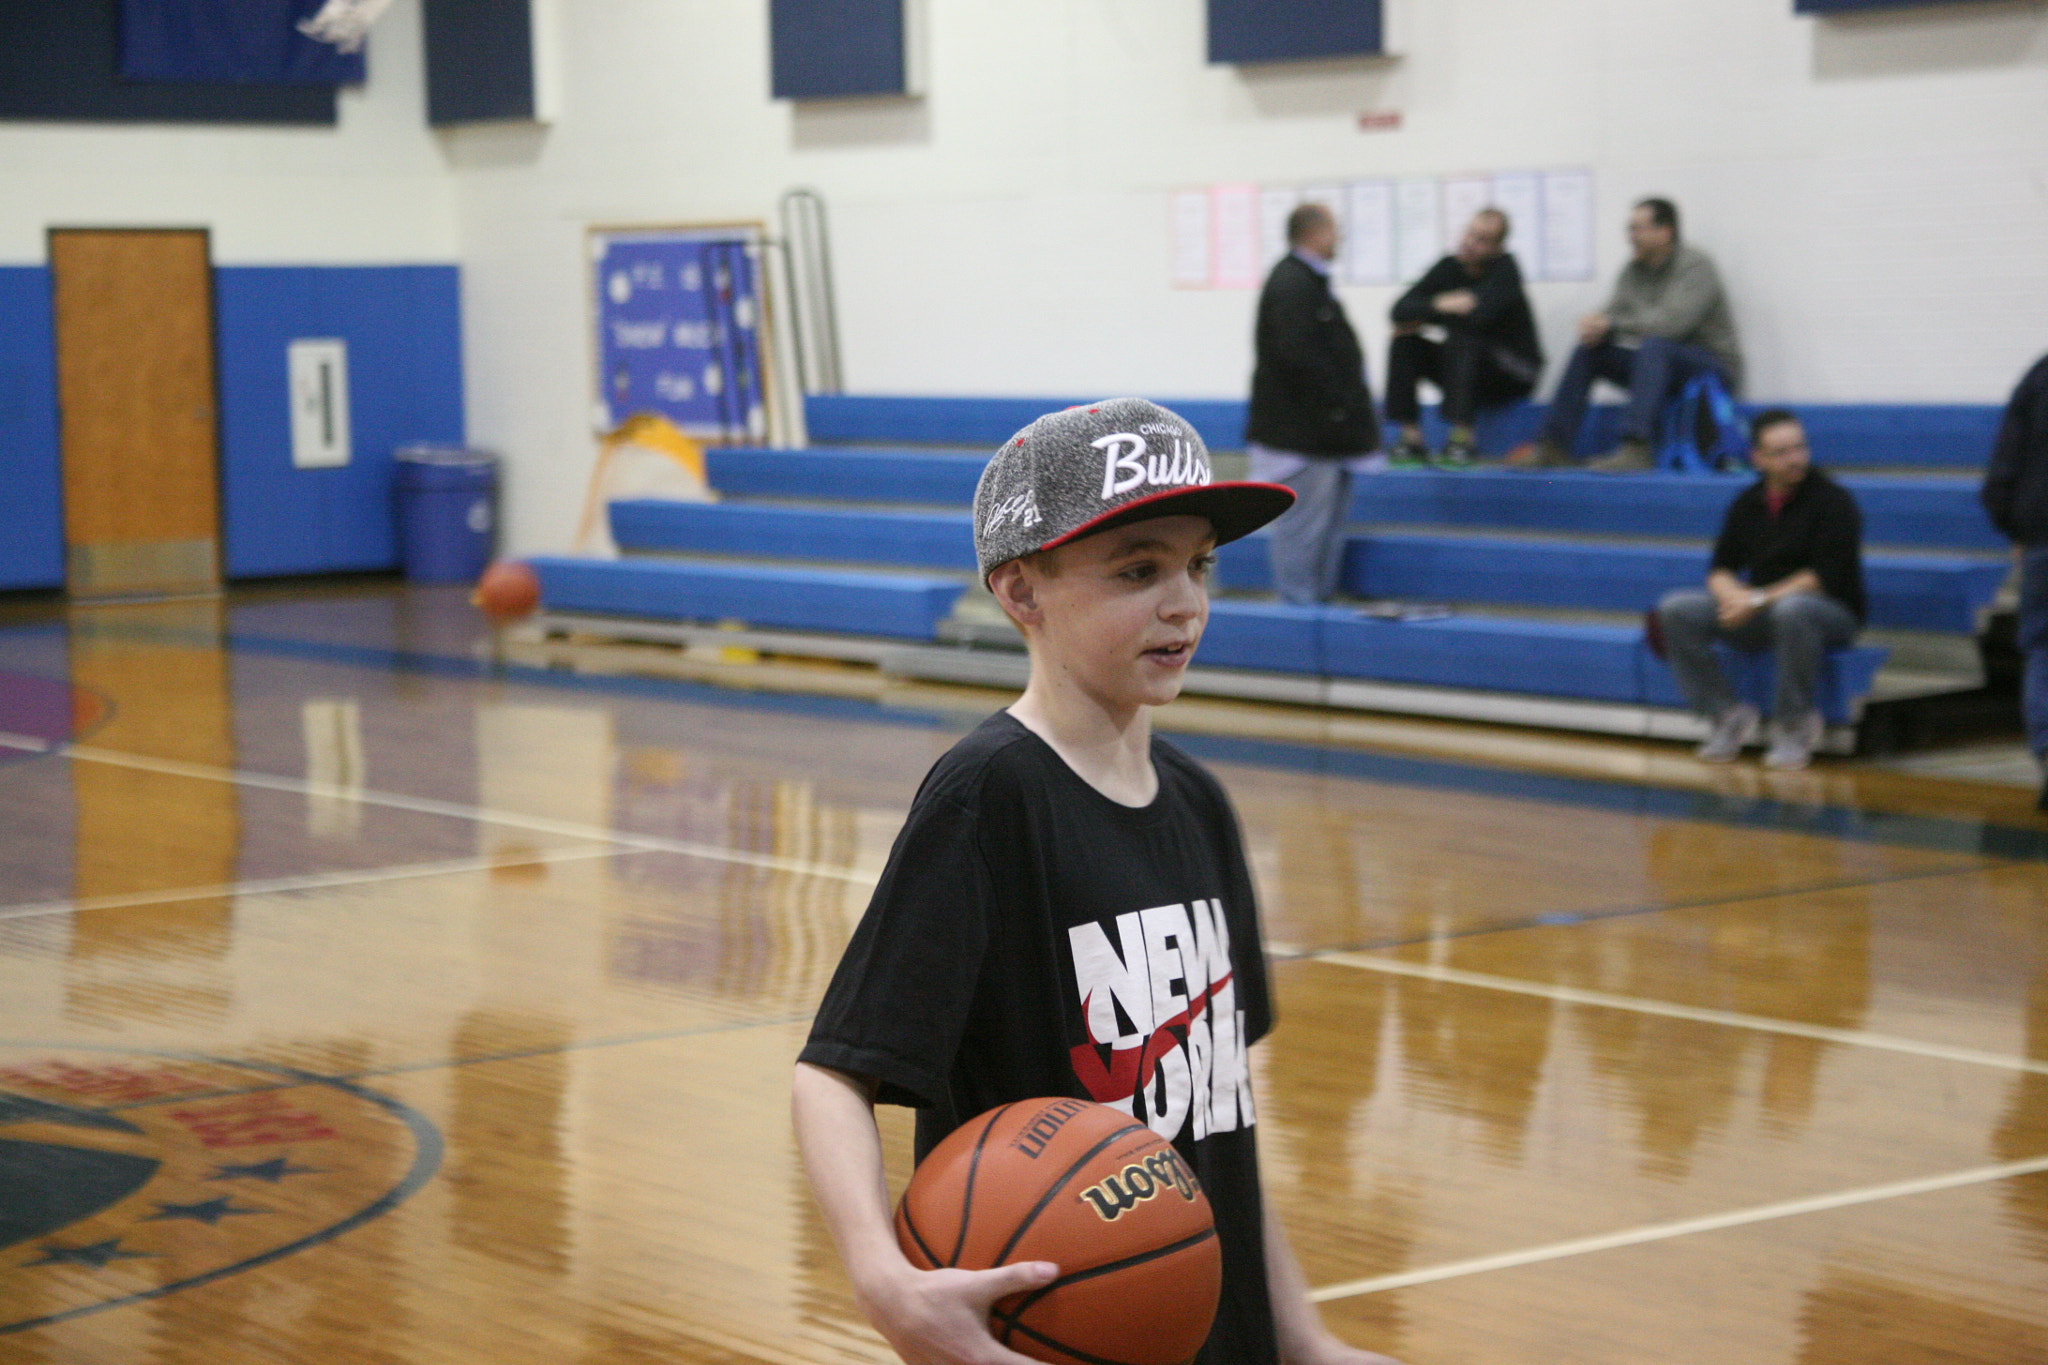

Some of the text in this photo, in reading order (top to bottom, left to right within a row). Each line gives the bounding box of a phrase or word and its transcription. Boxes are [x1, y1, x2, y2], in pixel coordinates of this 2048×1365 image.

[1090, 432, 1211, 500] Bulls
[1067, 897, 1236, 1046] NEW
[1069, 995, 1257, 1142] YORK
